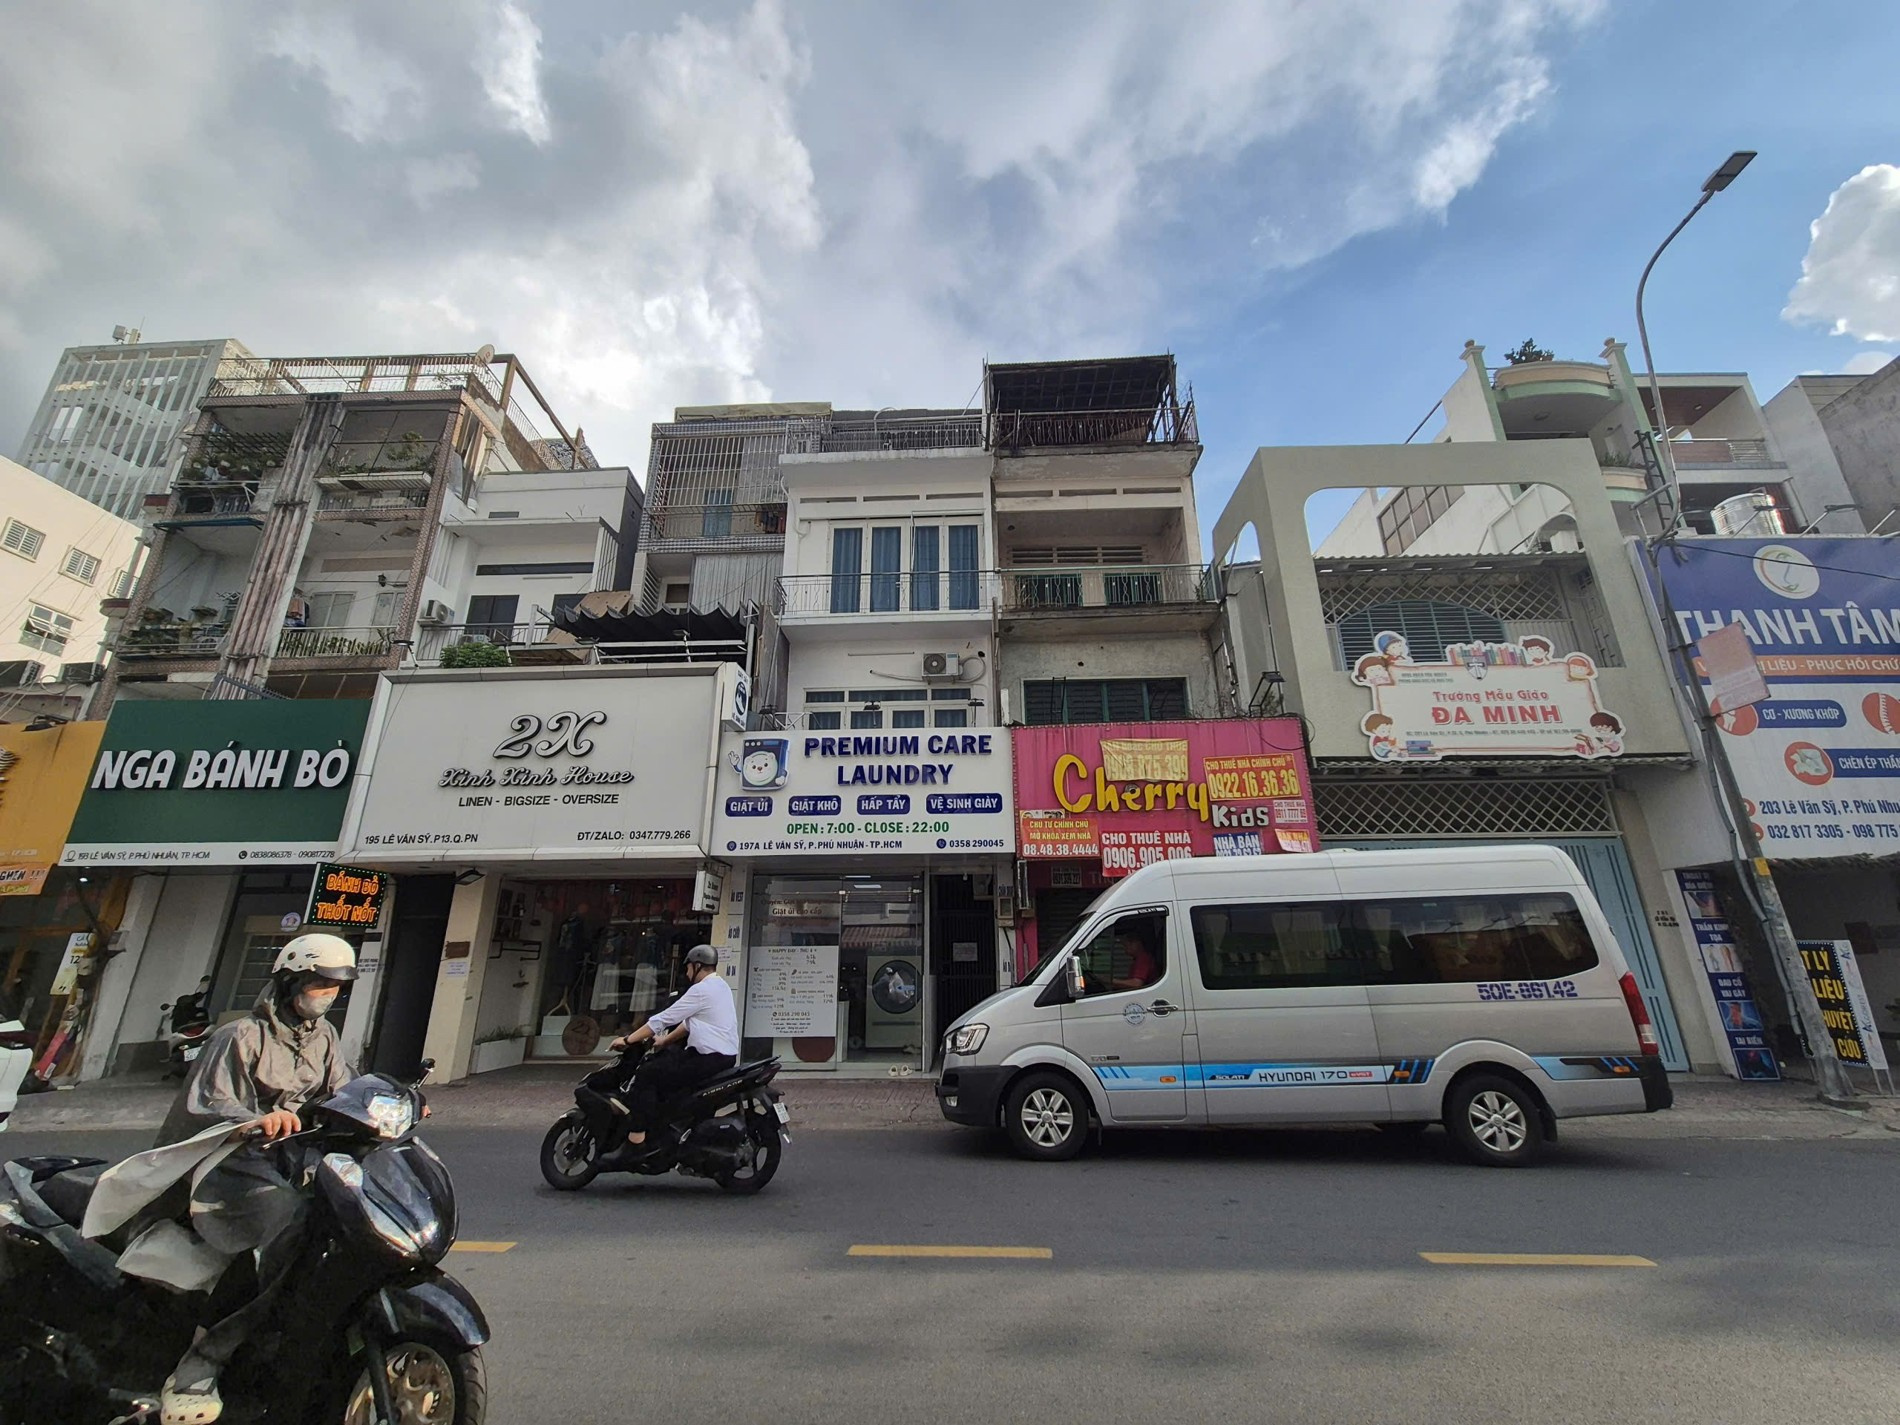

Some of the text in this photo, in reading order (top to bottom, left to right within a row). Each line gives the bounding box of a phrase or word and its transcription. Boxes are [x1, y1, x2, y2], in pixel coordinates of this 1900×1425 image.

[1674, 601, 1900, 645] THANH TÂM
[1768, 656, 1797, 673] LIỆU
[1808, 658, 1846, 673] PHỤC
[1433, 690, 1481, 703] Trường
[1517, 689, 1549, 700] Giáo
[1432, 704, 1563, 725] ĐA MINH
[493, 711, 607, 759] 2X
[804, 735, 993, 757] PREMIUM CARE
[91, 740, 350, 789] NGA BÁNH BÒ
[1205, 761, 1219, 770] CHO
[1865, 755, 1877, 769] ÉP
[438, 766, 634, 787] Xinh Xinh House
[837, 764, 953, 786] LAUNDRY
[1053, 753, 1209, 822] Cherry
[1208, 769, 1299, 798] 0922.16.36.36
[458, 796, 493, 807] LINEN
[504, 795, 551, 806] BIGSIZE
[562, 794, 620, 805] OVERSIZE
[817, 797, 838, 811] KHÔ
[861, 796, 883, 810] HẤP
[930, 795, 998, 811] VỆ SINH GIÀY
[1760, 801, 1781, 814] 203
[1799, 799, 1820, 814] Văn
[1841, 800, 1853, 814] P.
[577, 830, 691, 841] ĐT/ZALO: 0347.779.266
[786, 823, 818, 835] OPEN
[826, 822, 855, 834] 7:00
[864, 822, 903, 833] CLOSE
[911, 821, 949, 833] 22:00
[1767, 825, 1790, 838] 032
[1792, 825, 1812, 838] 817
[1814, 824, 1843, 838] 3305
[1852, 824, 1875, 838] 098
[1875, 824, 1898, 838] 775
[365, 835, 380, 844] 195
[382, 833, 395, 844] LÊ
[949, 839, 1004, 848] 0358 290045
[1061, 832, 1076, 840] XEM
[1101, 829, 1191, 845] CHO THUÊ NHÀ
[1213, 832, 1260, 849] NHÀ BÁN
[739, 842, 760, 850] 197A
[870, 841, 902, 849] TP.HCM
[1023, 843, 1099, 856] 08.48.38.4444
[326, 870, 361, 893] BÁNH
[1812, 974, 1845, 1004] LIỆU
[1259, 1071, 1316, 1082] HYUNDAI
[1321, 1070, 1348, 1079] 170
